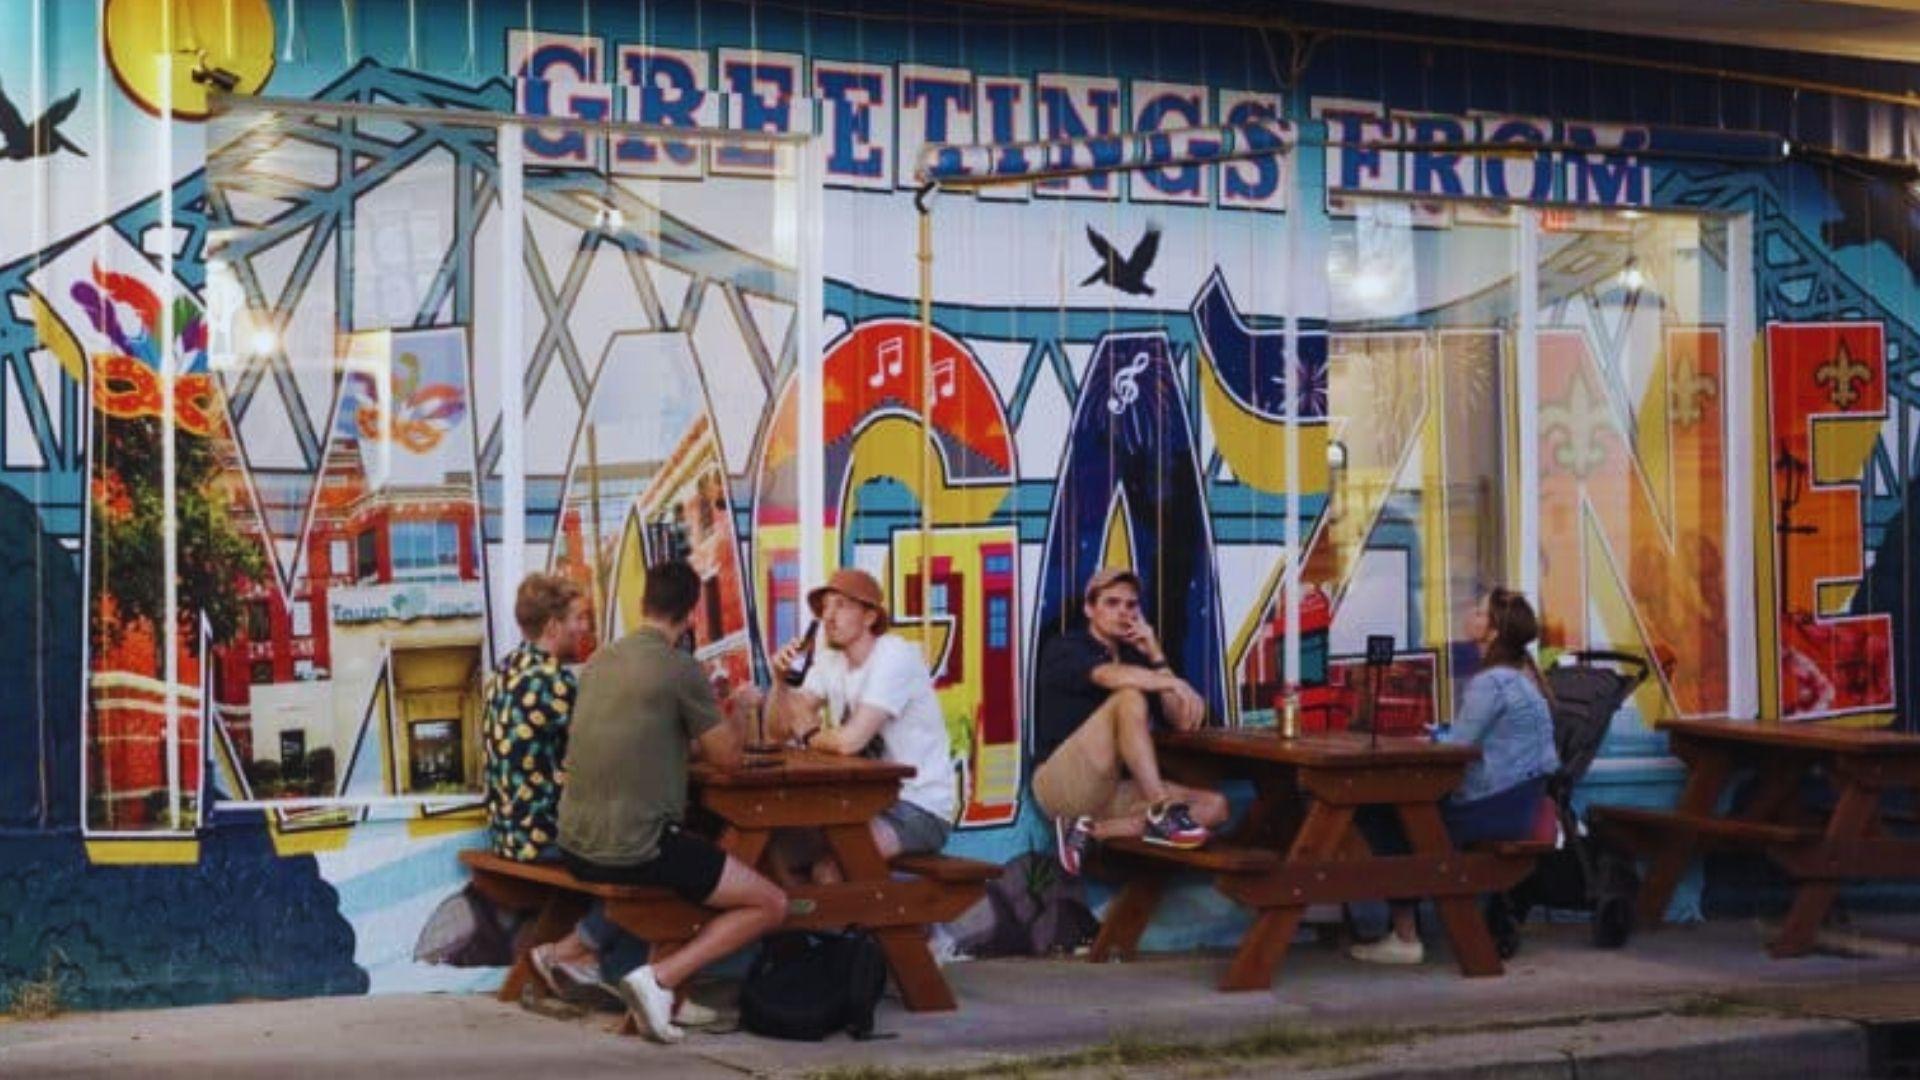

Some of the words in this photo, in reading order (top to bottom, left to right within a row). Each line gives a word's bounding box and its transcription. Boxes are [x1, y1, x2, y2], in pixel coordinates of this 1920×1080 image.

[518, 44, 1290, 201] GREETINGS
[1321, 108, 1650, 212] FROM
[28, 226, 1896, 837] MAGAZINE
